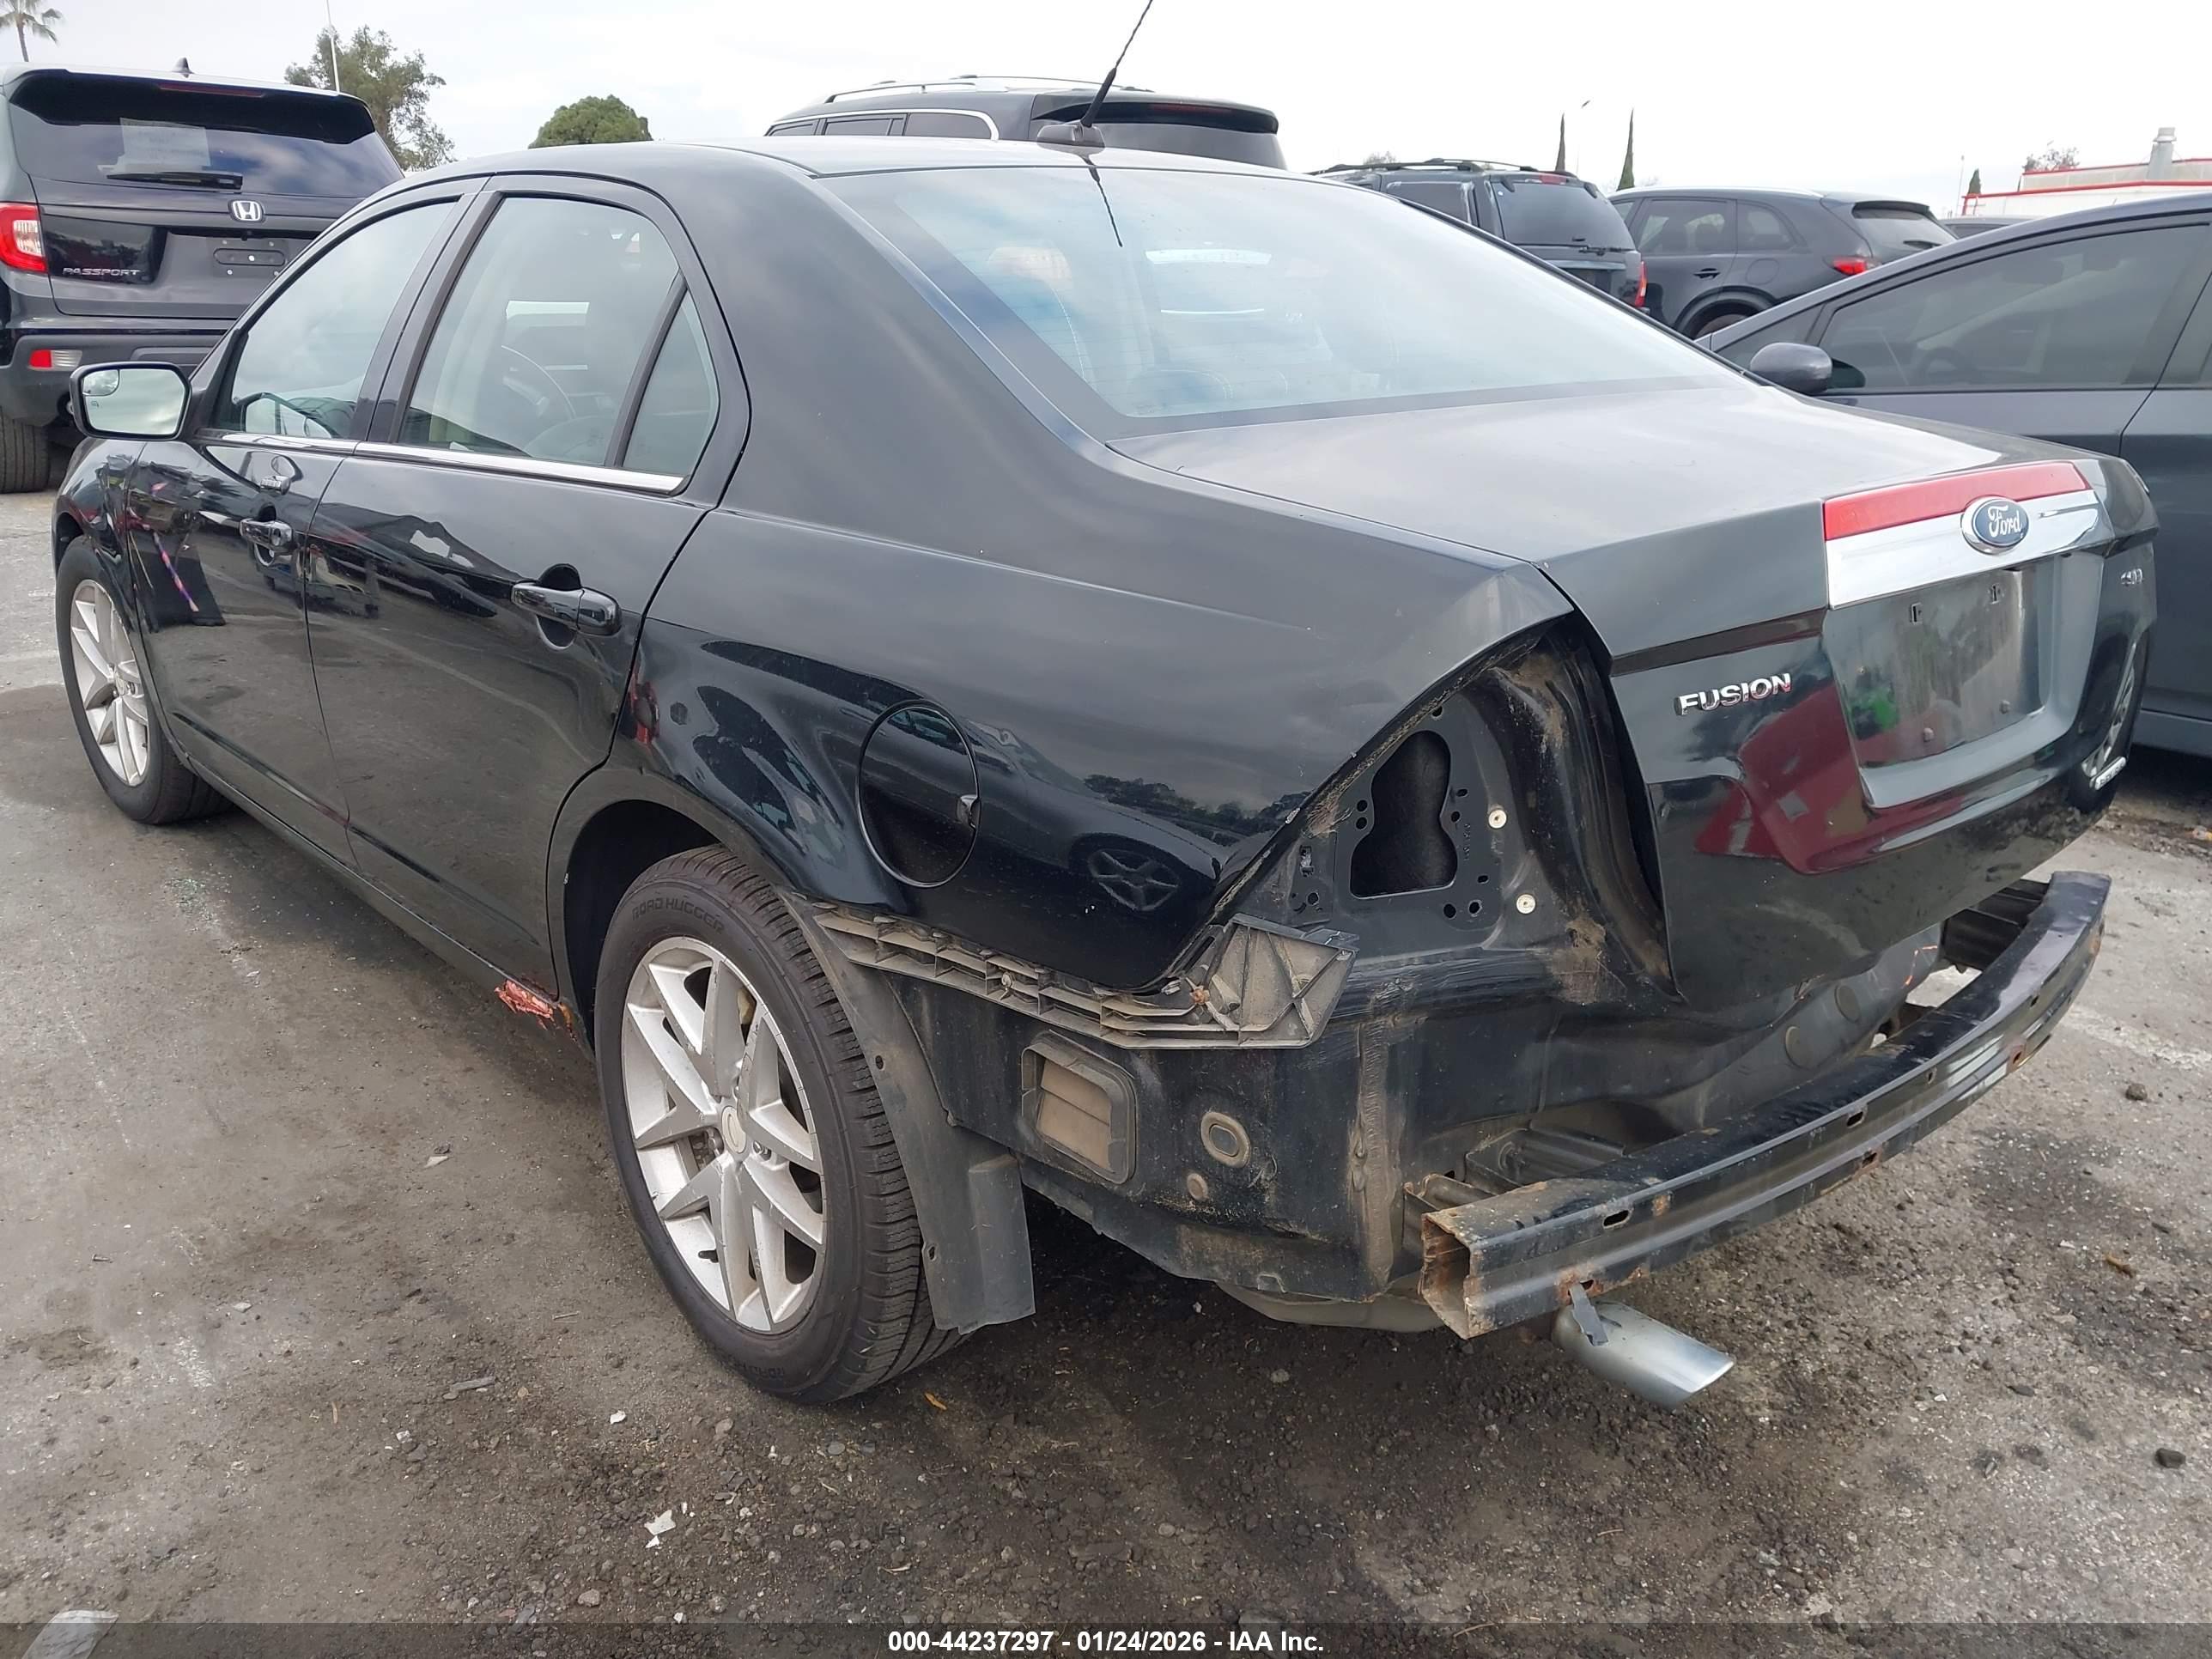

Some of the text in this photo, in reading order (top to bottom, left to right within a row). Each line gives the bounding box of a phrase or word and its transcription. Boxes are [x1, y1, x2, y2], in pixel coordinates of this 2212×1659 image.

[63, 267, 141, 276] PASSPORT
[1987, 505, 2022, 538] Ford
[1675, 672, 1792, 715] FUSION
[632, 895, 725, 935] ROAD HUGGER
